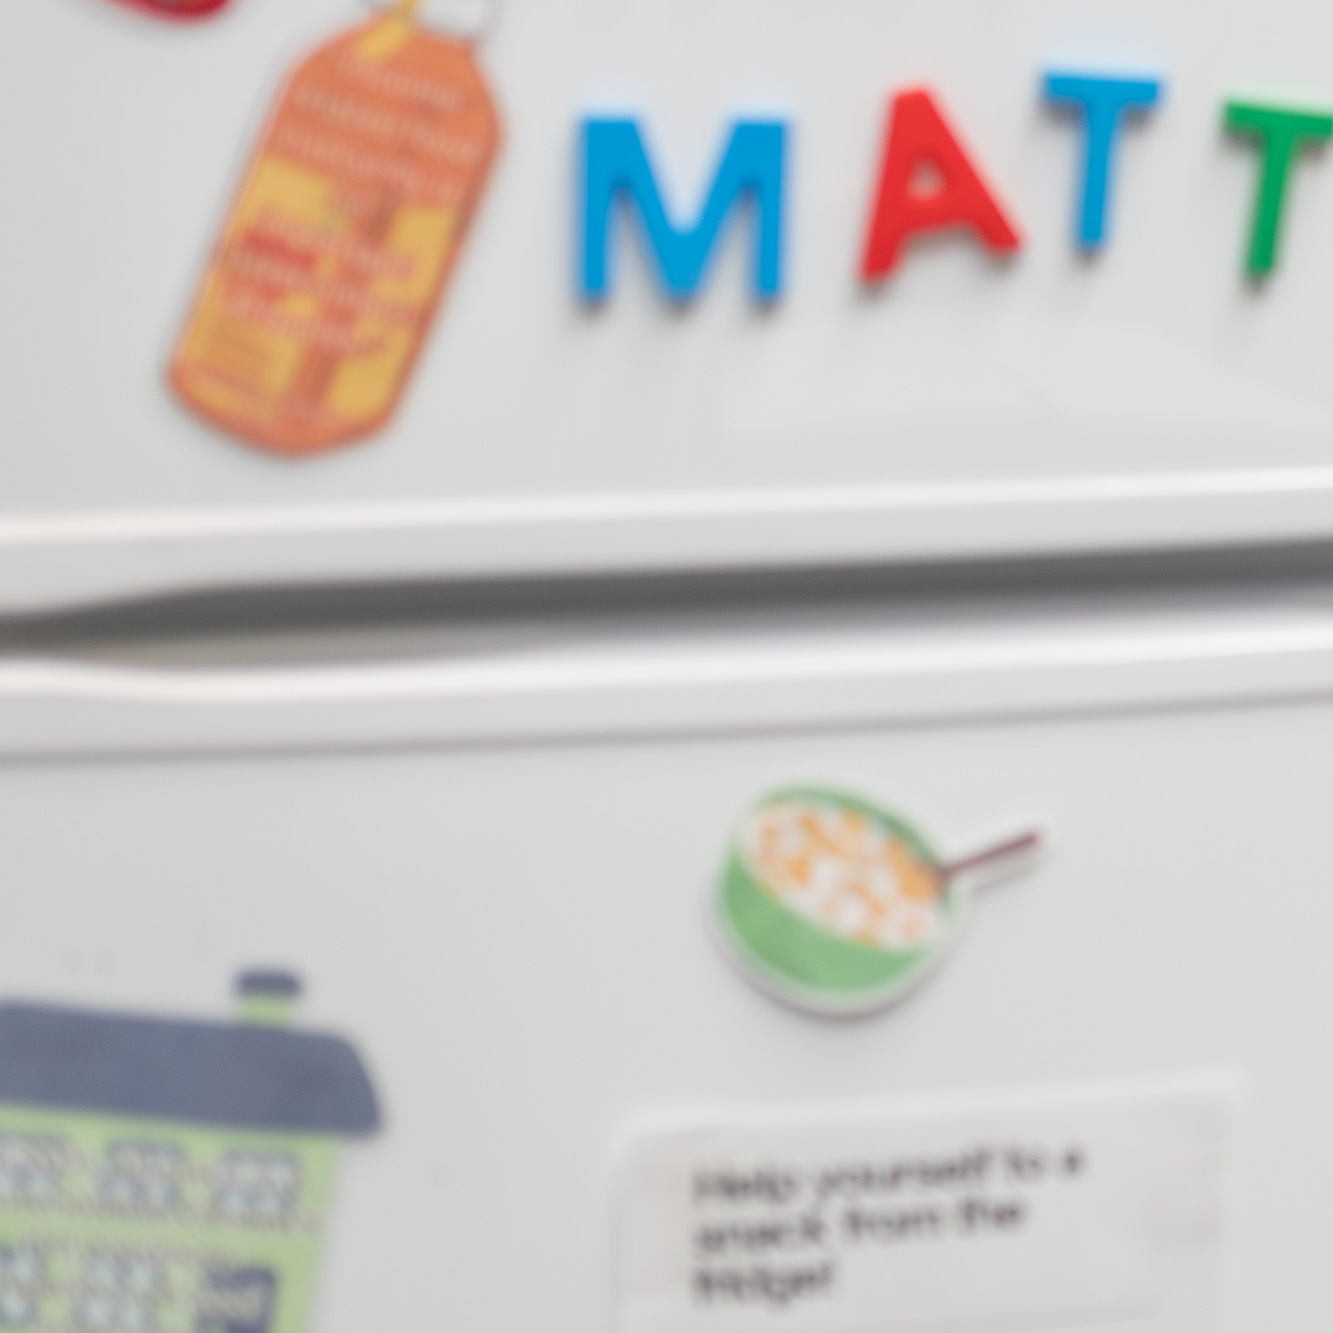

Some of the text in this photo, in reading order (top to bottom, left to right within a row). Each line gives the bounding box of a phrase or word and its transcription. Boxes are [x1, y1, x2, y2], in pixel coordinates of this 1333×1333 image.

[815, 1143, 994, 1203] yourself
[1006, 1142, 1047, 1181] to
[1057, 1146, 1087, 1178] a
[693, 1195, 1027, 1255] snack from the
